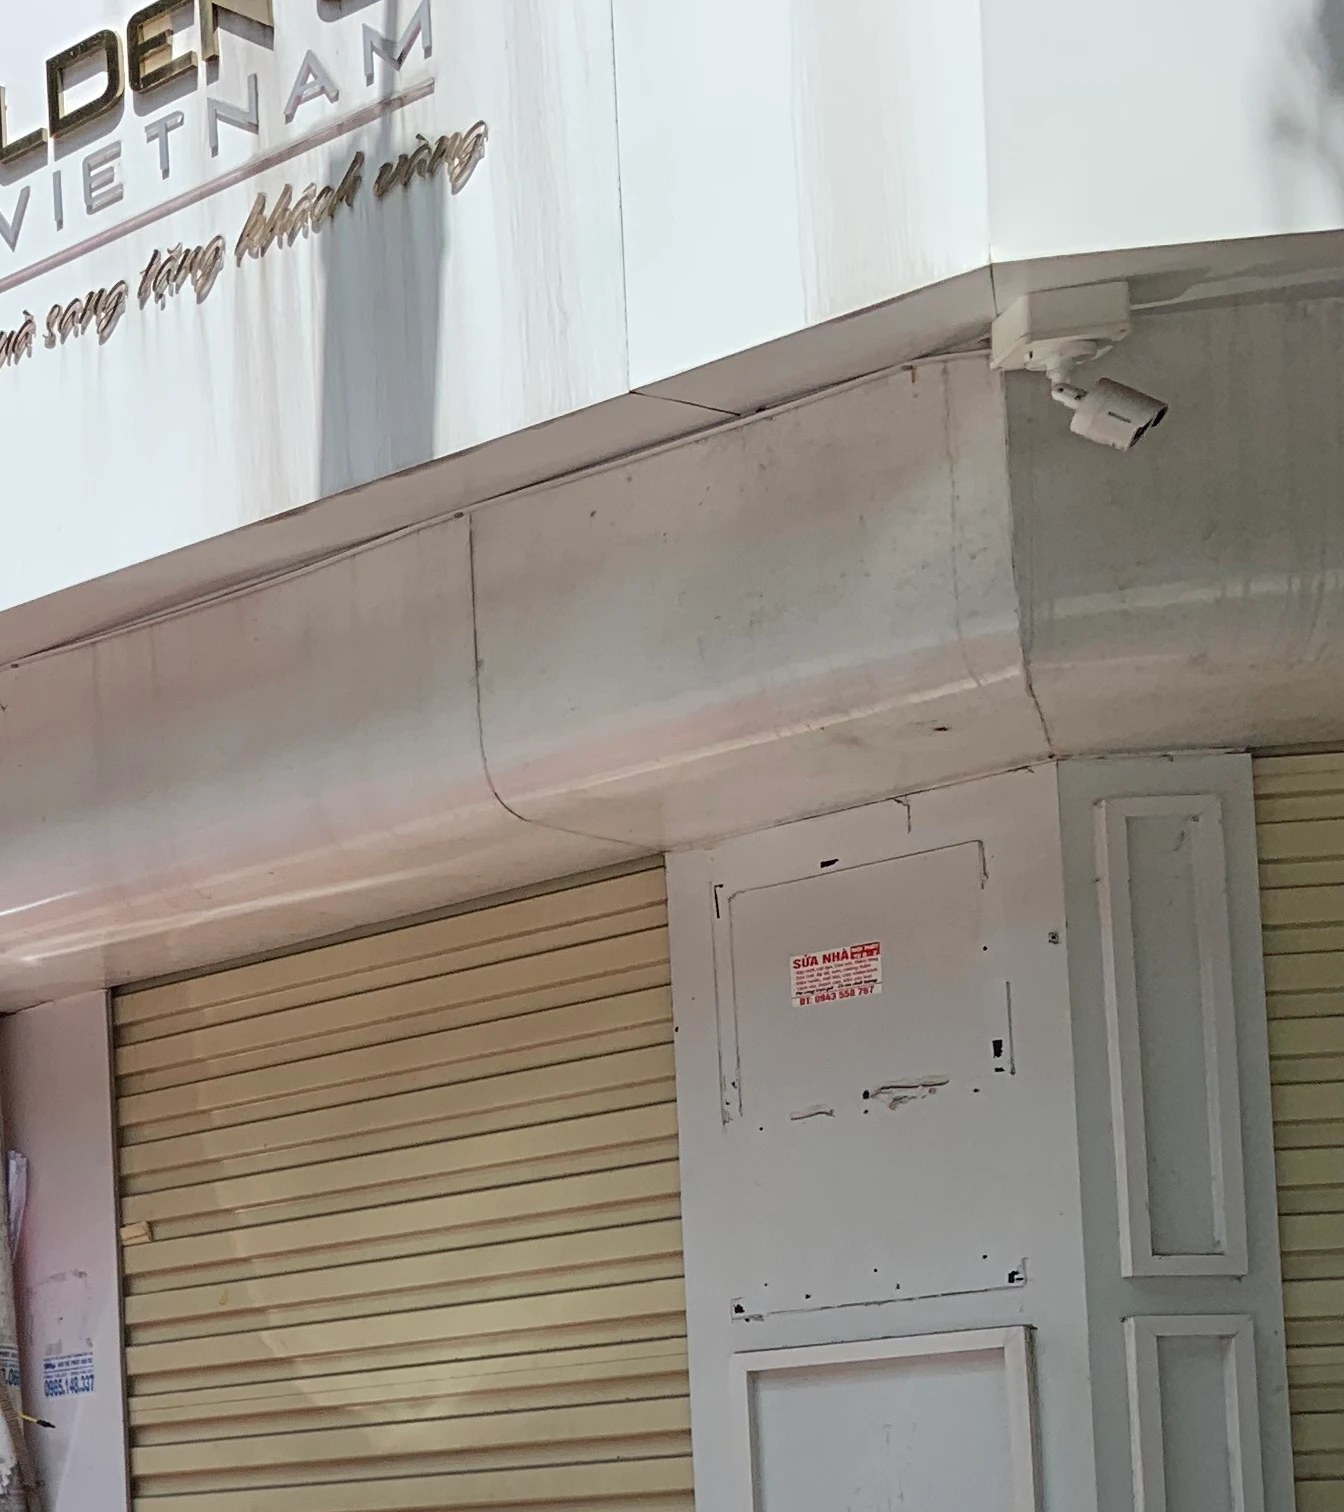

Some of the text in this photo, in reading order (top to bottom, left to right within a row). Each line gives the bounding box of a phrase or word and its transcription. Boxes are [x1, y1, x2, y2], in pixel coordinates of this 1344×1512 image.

[45, 280, 128, 345] sang
[138, 235, 226, 309] tặng
[235, 151, 364, 266] khách
[373, 120, 489, 195] vàng
[793, 954, 819, 969] SỬA
[823, 948, 849, 964] NHÀ
